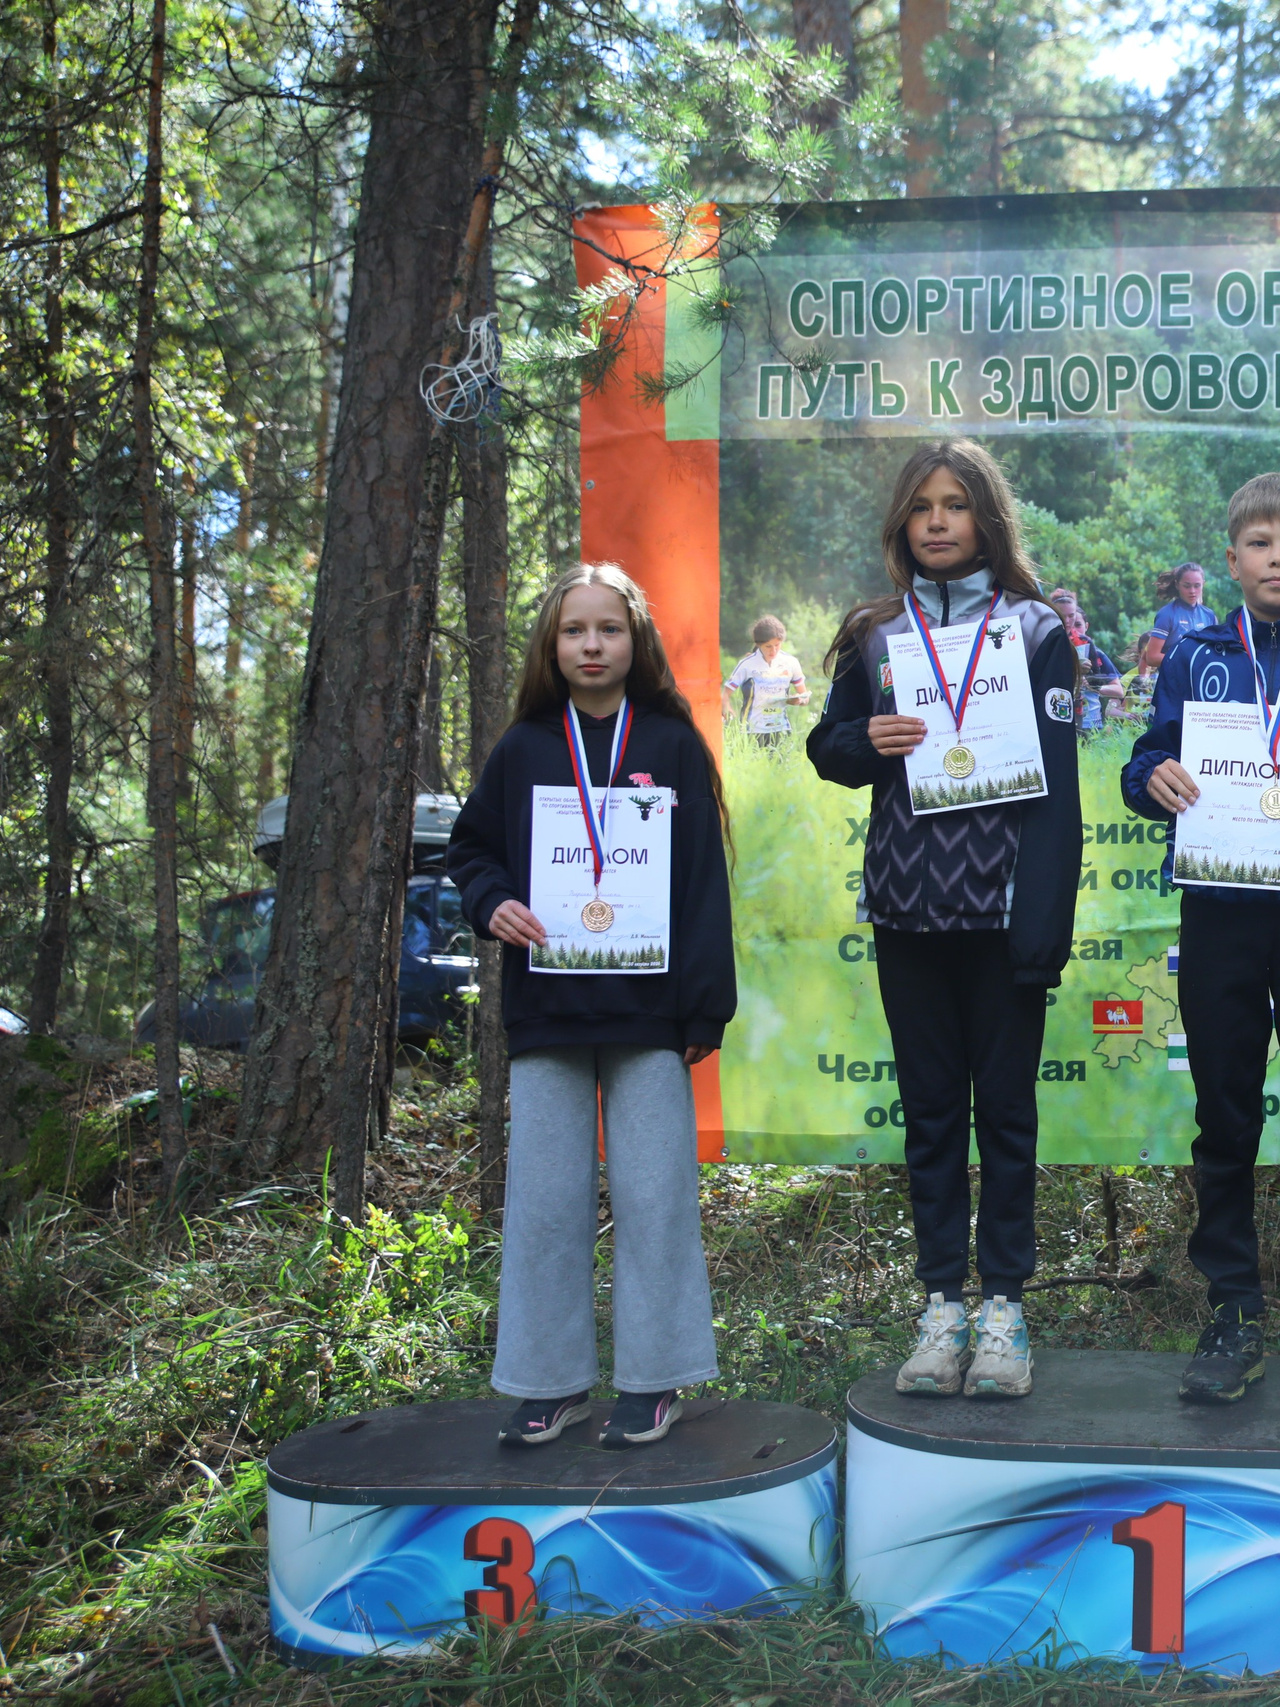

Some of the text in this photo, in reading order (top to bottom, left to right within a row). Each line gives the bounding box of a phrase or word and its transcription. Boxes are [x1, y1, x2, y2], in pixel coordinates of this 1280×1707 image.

[789, 271, 1193, 338] СПОРТИВНОЕ
[758, 360, 908, 419] ПУТЬ
[929, 358, 962, 417] К
[464, 1516, 538, 1637] 3
[1112, 1500, 1186, 1654] 1
